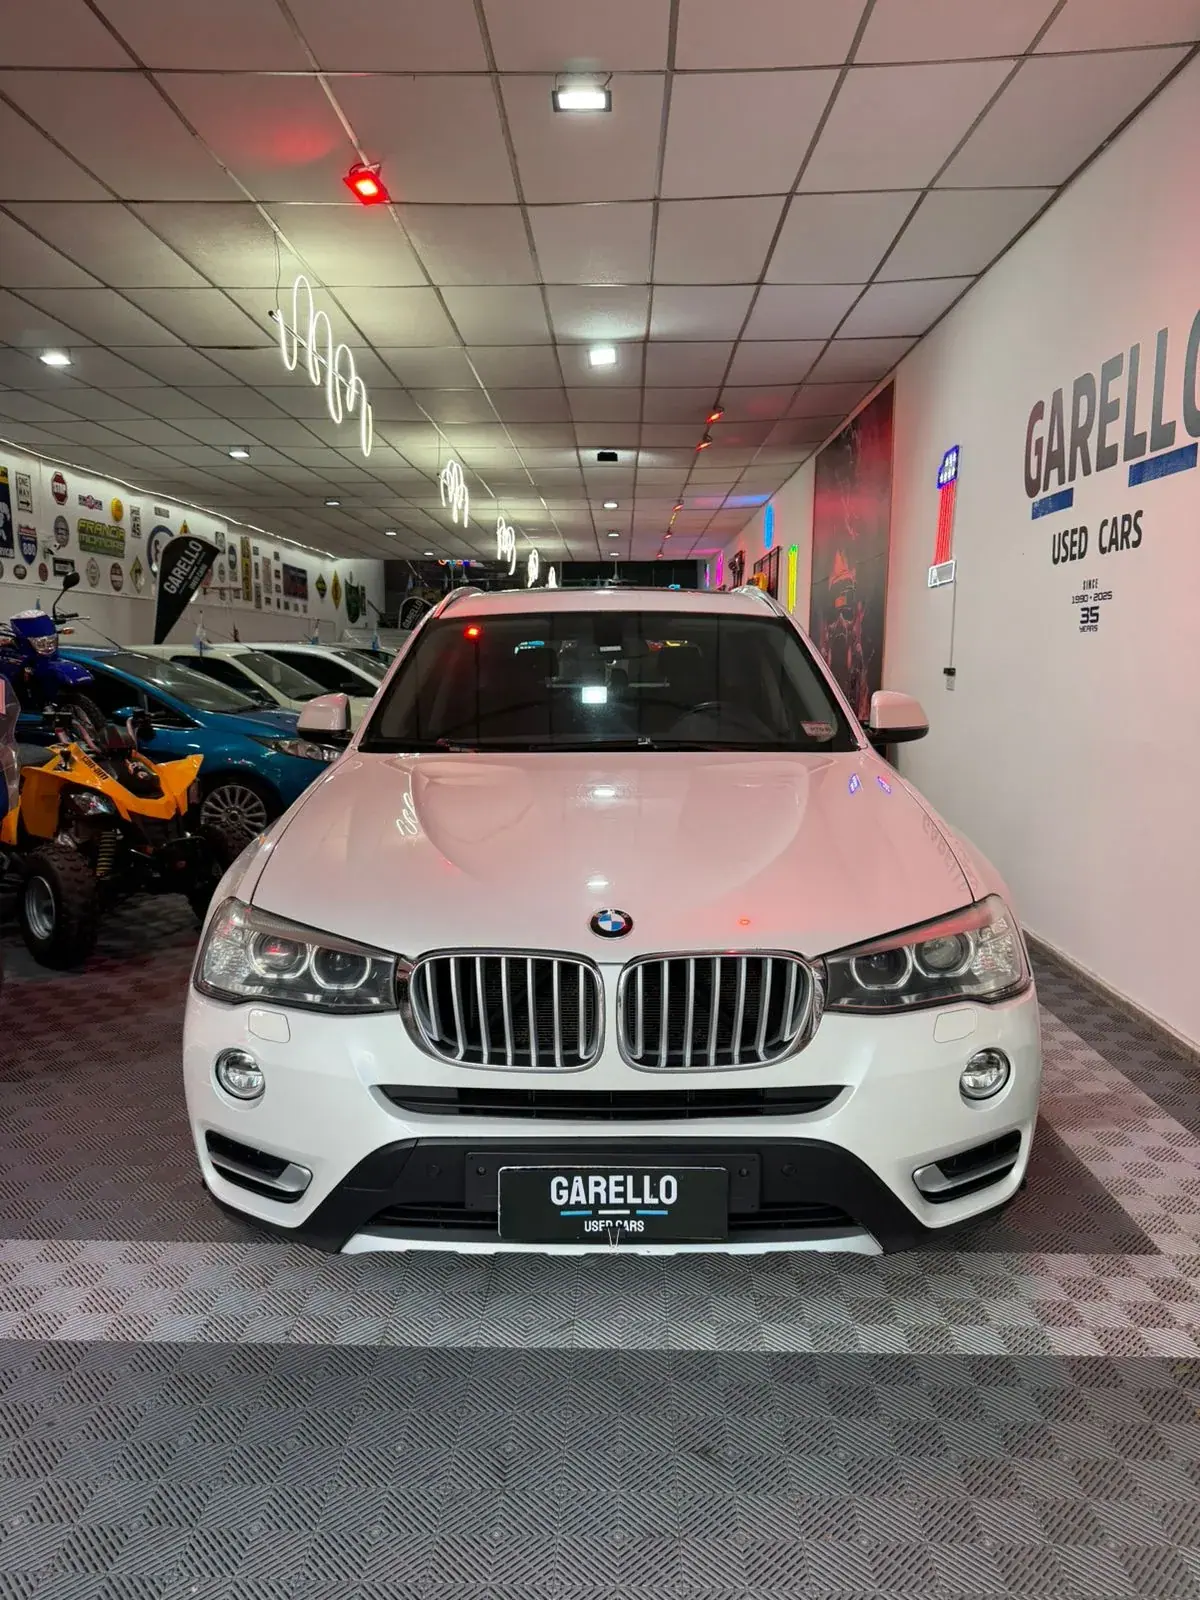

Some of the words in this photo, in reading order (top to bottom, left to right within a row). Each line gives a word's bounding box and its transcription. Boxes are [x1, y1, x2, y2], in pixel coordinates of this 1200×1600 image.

[1052, 526, 1088, 565] USED
[1099, 509, 1144, 555] CARS
[163, 540, 203, 594] GARELLO
[1082, 578, 1098, 590] SINCE
[1080, 606, 1100, 624] 35
[550, 1175, 678, 1206] GARELLO
